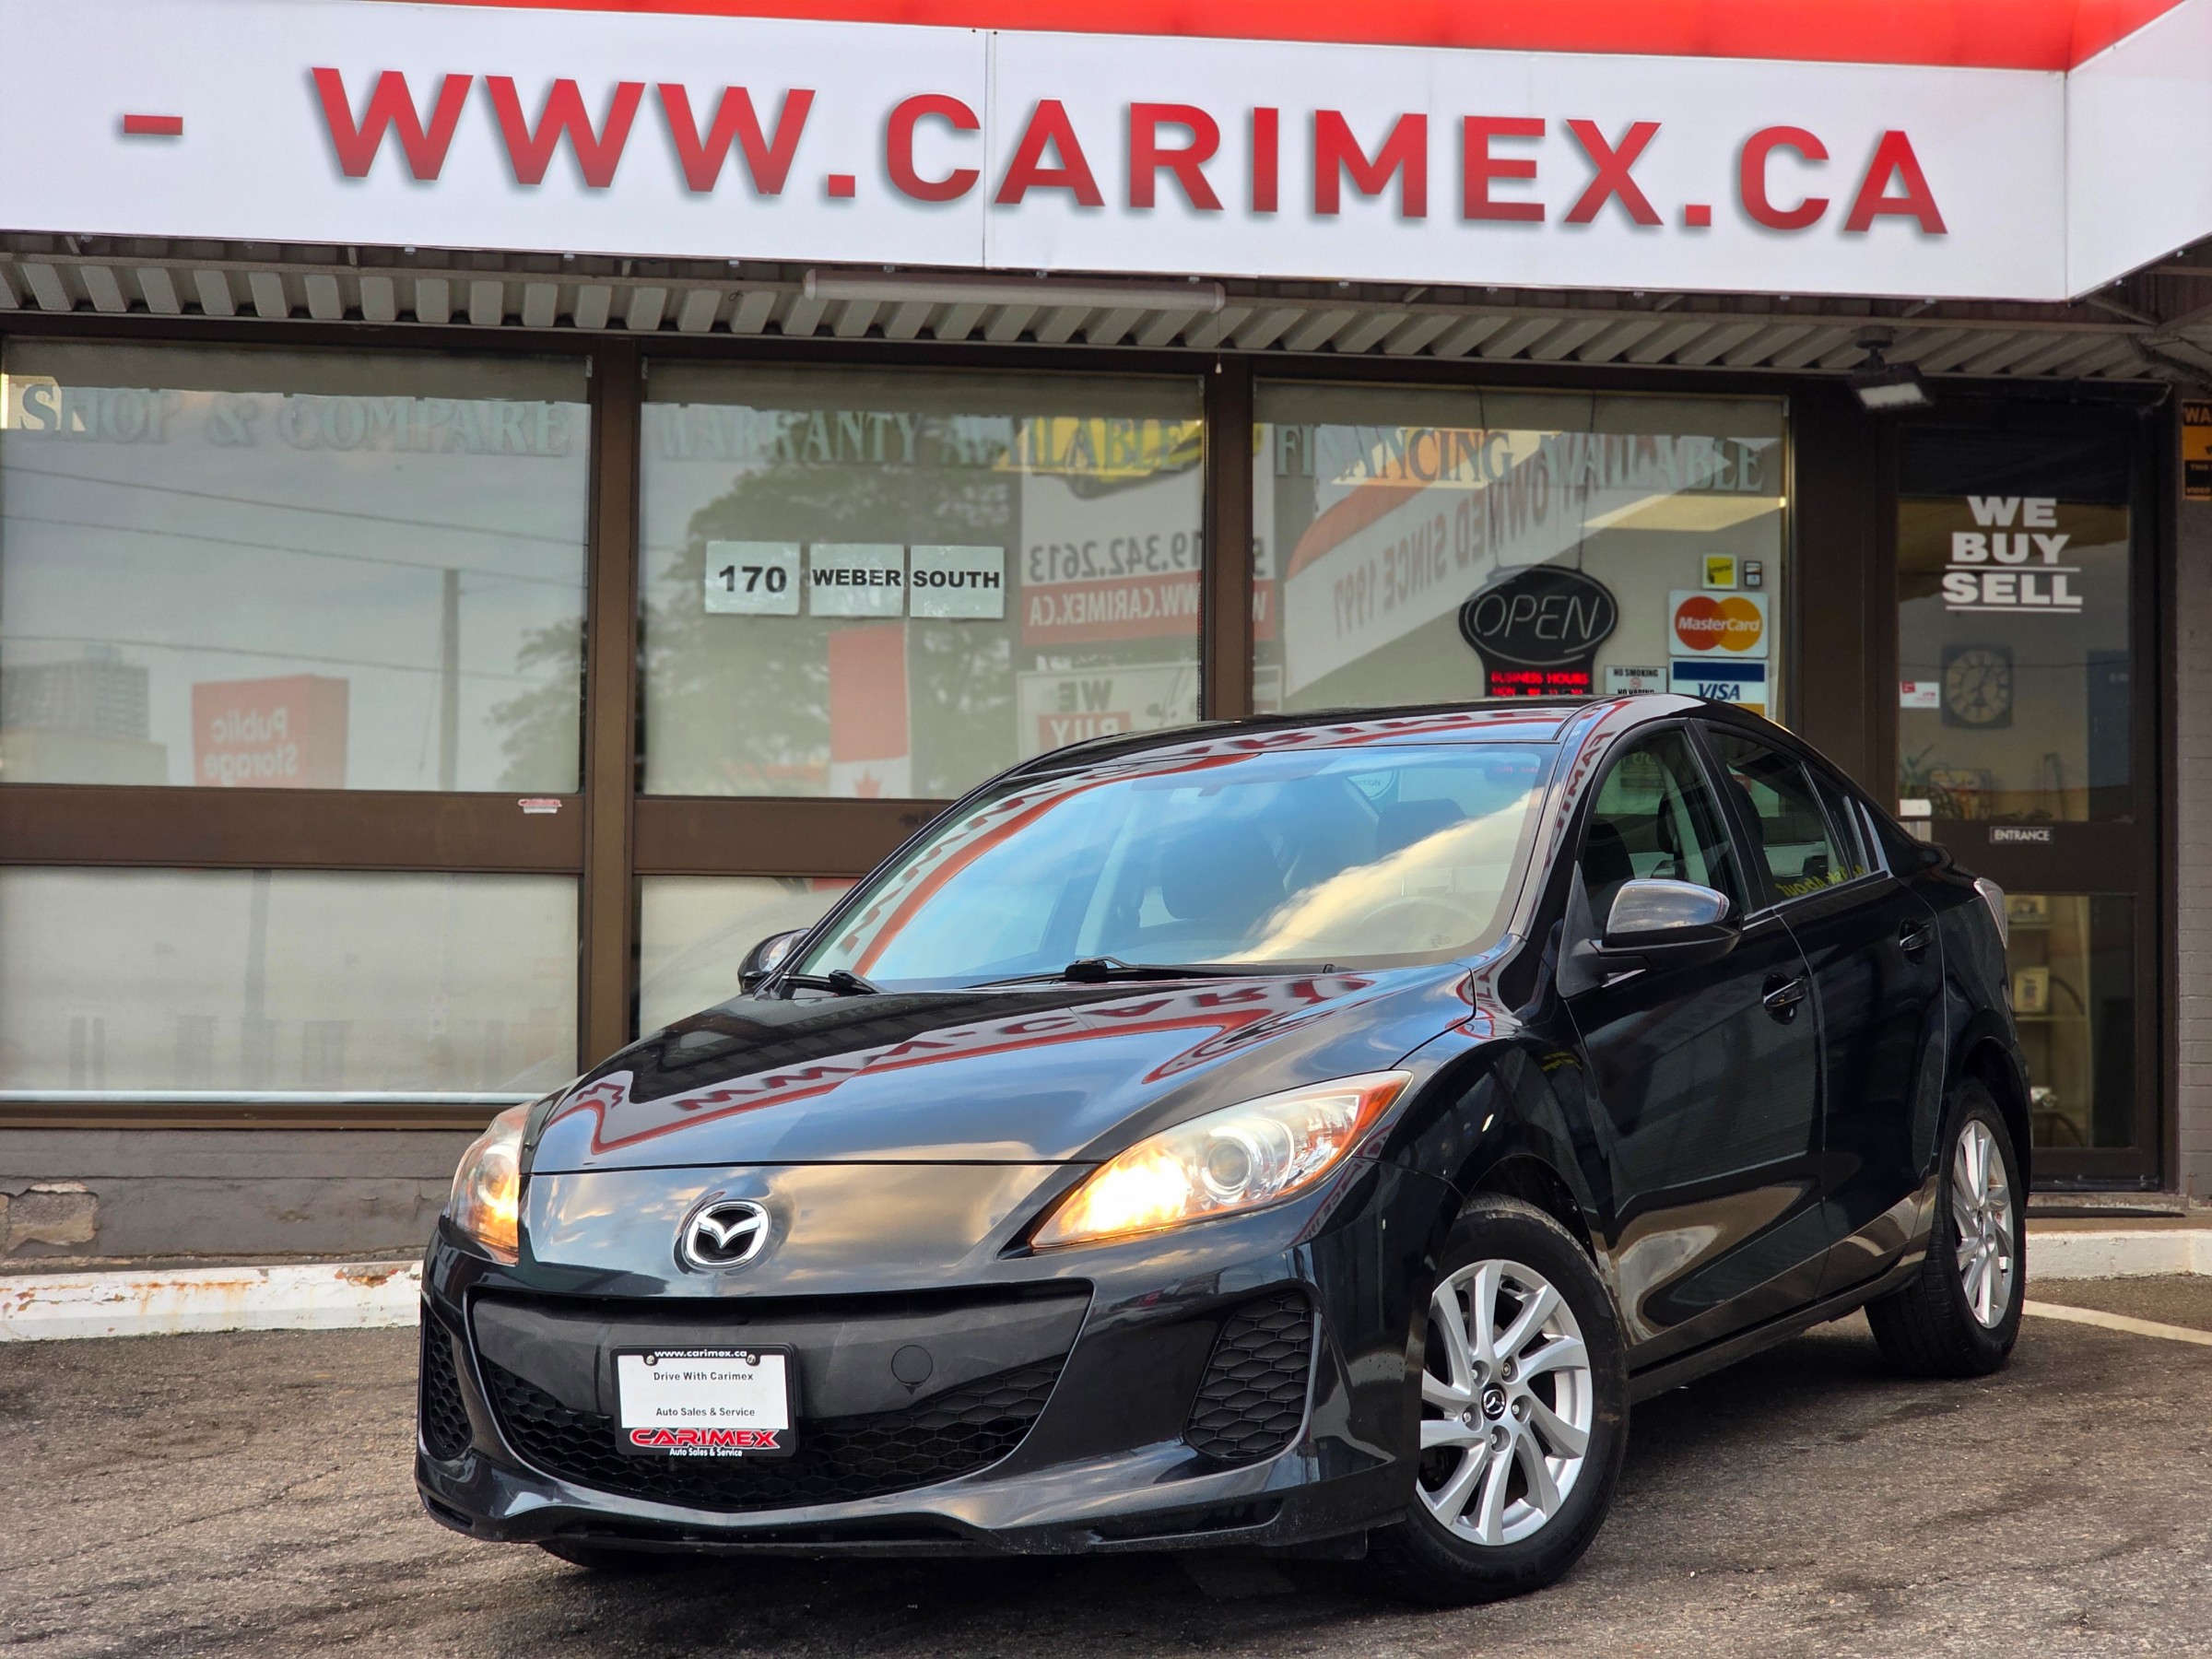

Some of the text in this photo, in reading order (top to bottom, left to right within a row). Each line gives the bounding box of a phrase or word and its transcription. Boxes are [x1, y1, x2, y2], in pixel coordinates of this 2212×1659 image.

[312, 66, 1947, 234] WWW.CARIMEX.CA
[22, 383, 181, 444] SHOP
[280, 395, 571, 458] COMPARE
[656, 407, 920, 463] WARRANTY
[1275, 425, 1512, 483] FINANCING
[1967, 495, 2057, 528] WE
[1952, 532, 2070, 564] BUY
[718, 565, 1000, 593] 170 WEBER SOUTH
[1942, 572, 2082, 606] SELL
[1474, 594, 1601, 640] OPEN
[1677, 616, 1761, 633] MasterCard
[1547, 672, 1589, 684] HOURS
[1614, 668, 1658, 677] NO SMOKING
[1699, 683, 1741, 700] VISA
[1994, 829, 2051, 843] ENTRANCE
[653, 1349, 747, 1358] www.carimex.ca
[653, 1371, 754, 1381] Drive With Carimex
[655, 1407, 755, 1417] Auto Sales & Service
[629, 1429, 781, 1449] CARIMEX
[669, 1447, 743, 1457] Auto Sales & Service
